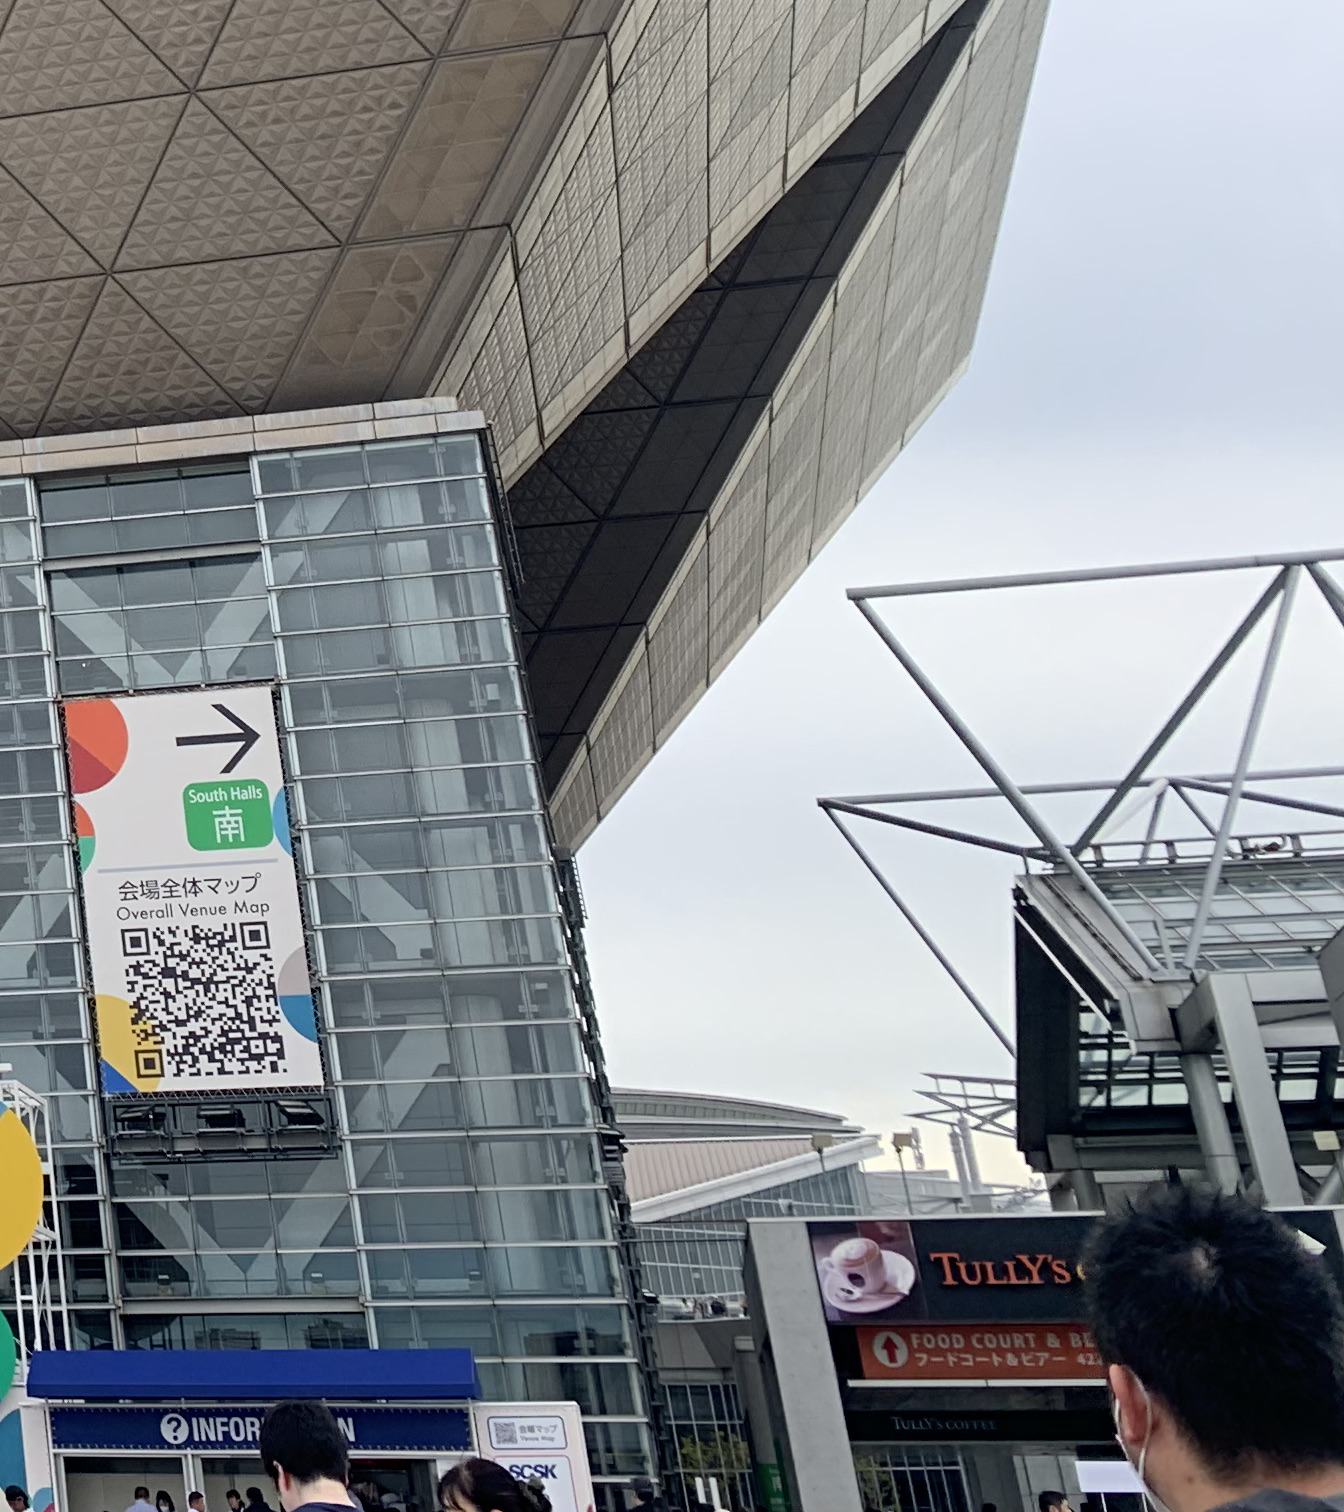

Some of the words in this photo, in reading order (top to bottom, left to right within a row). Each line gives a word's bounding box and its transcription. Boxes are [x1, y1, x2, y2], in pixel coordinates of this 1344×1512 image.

[188, 787, 228, 803] South
[230, 785, 263, 801] Halls
[212, 805, 245, 843] 南
[118, 872, 262, 902] 会場全体マップ
[116, 903, 174, 921] Overall
[178, 903, 227, 917] Venue
[234, 900, 270, 917] Map
[912, 1333, 964, 1349] FOOD
[971, 1333, 1035, 1349] COURT
[192, 1416, 356, 1442] INFORN
[509, 1464, 558, 1480] SCSK
